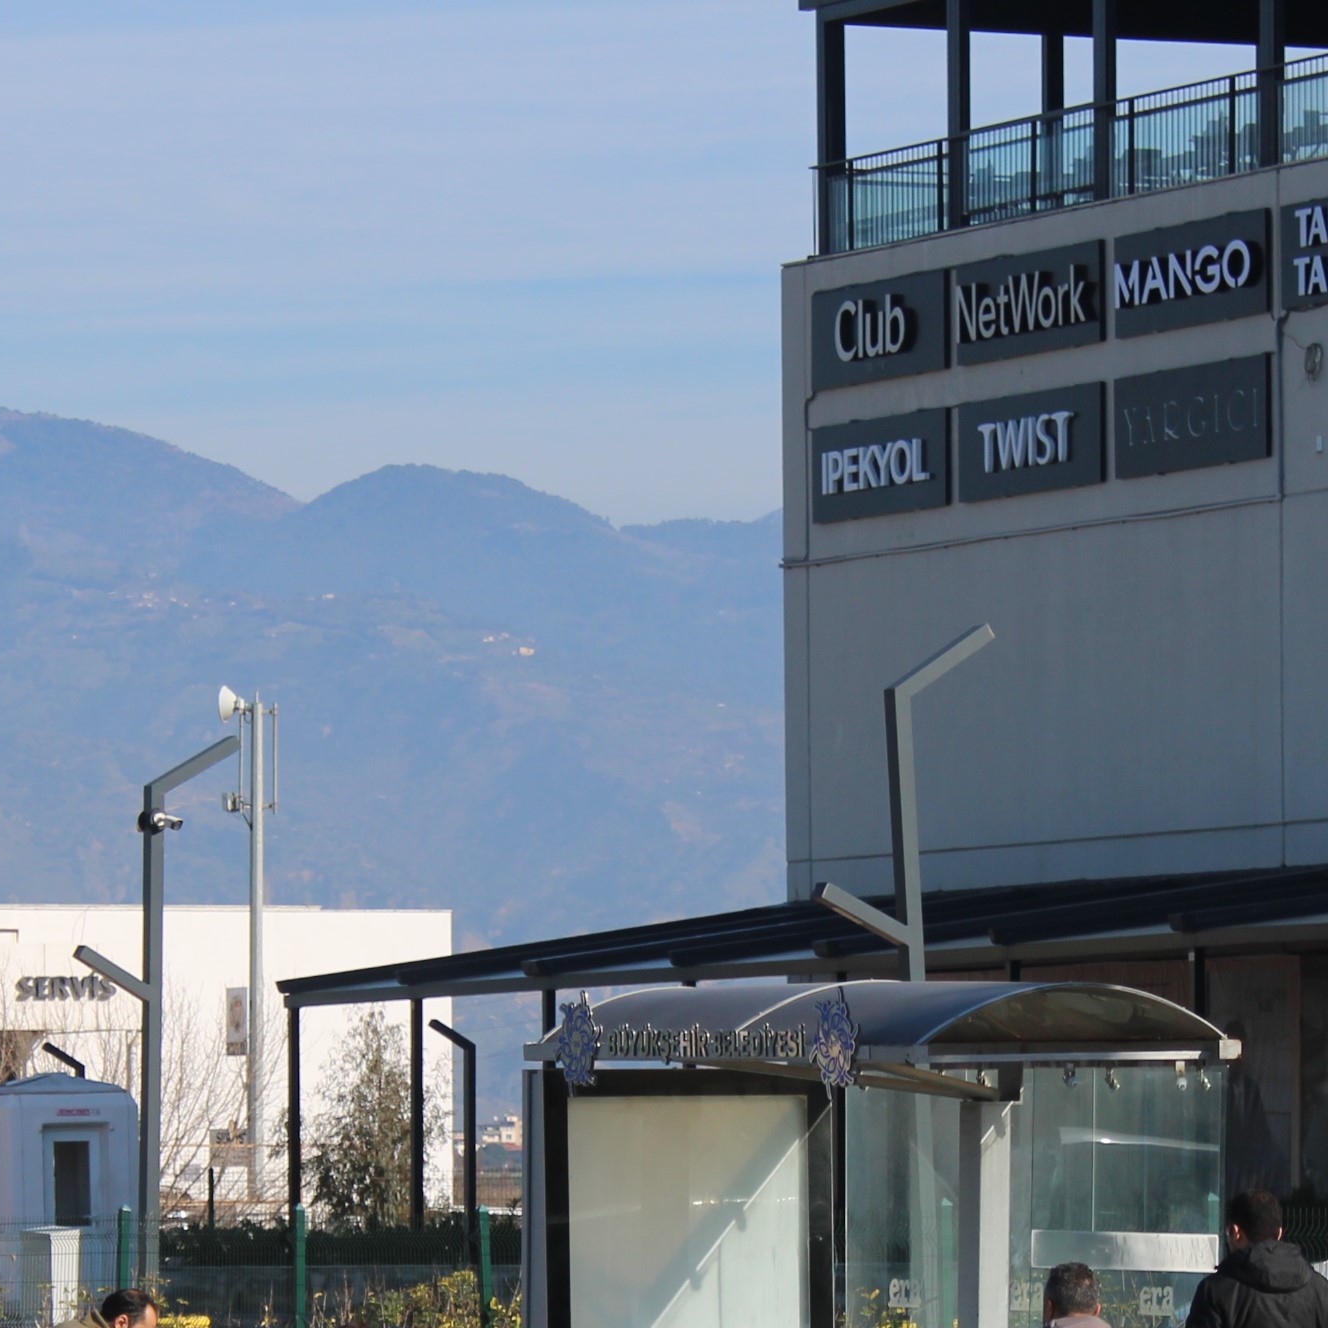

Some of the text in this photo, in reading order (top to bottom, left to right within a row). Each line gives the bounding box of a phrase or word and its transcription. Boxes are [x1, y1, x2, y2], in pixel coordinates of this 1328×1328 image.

[956, 264, 1086, 343] NetWork
[1114, 239, 1251, 309] MANGO
[834, 294, 906, 362] Club
[821, 438, 931, 496] IPEKYOL
[977, 410, 1075, 474] TWIST
[889, 1278, 922, 1299] era
[1139, 1285, 1173, 1306] era
